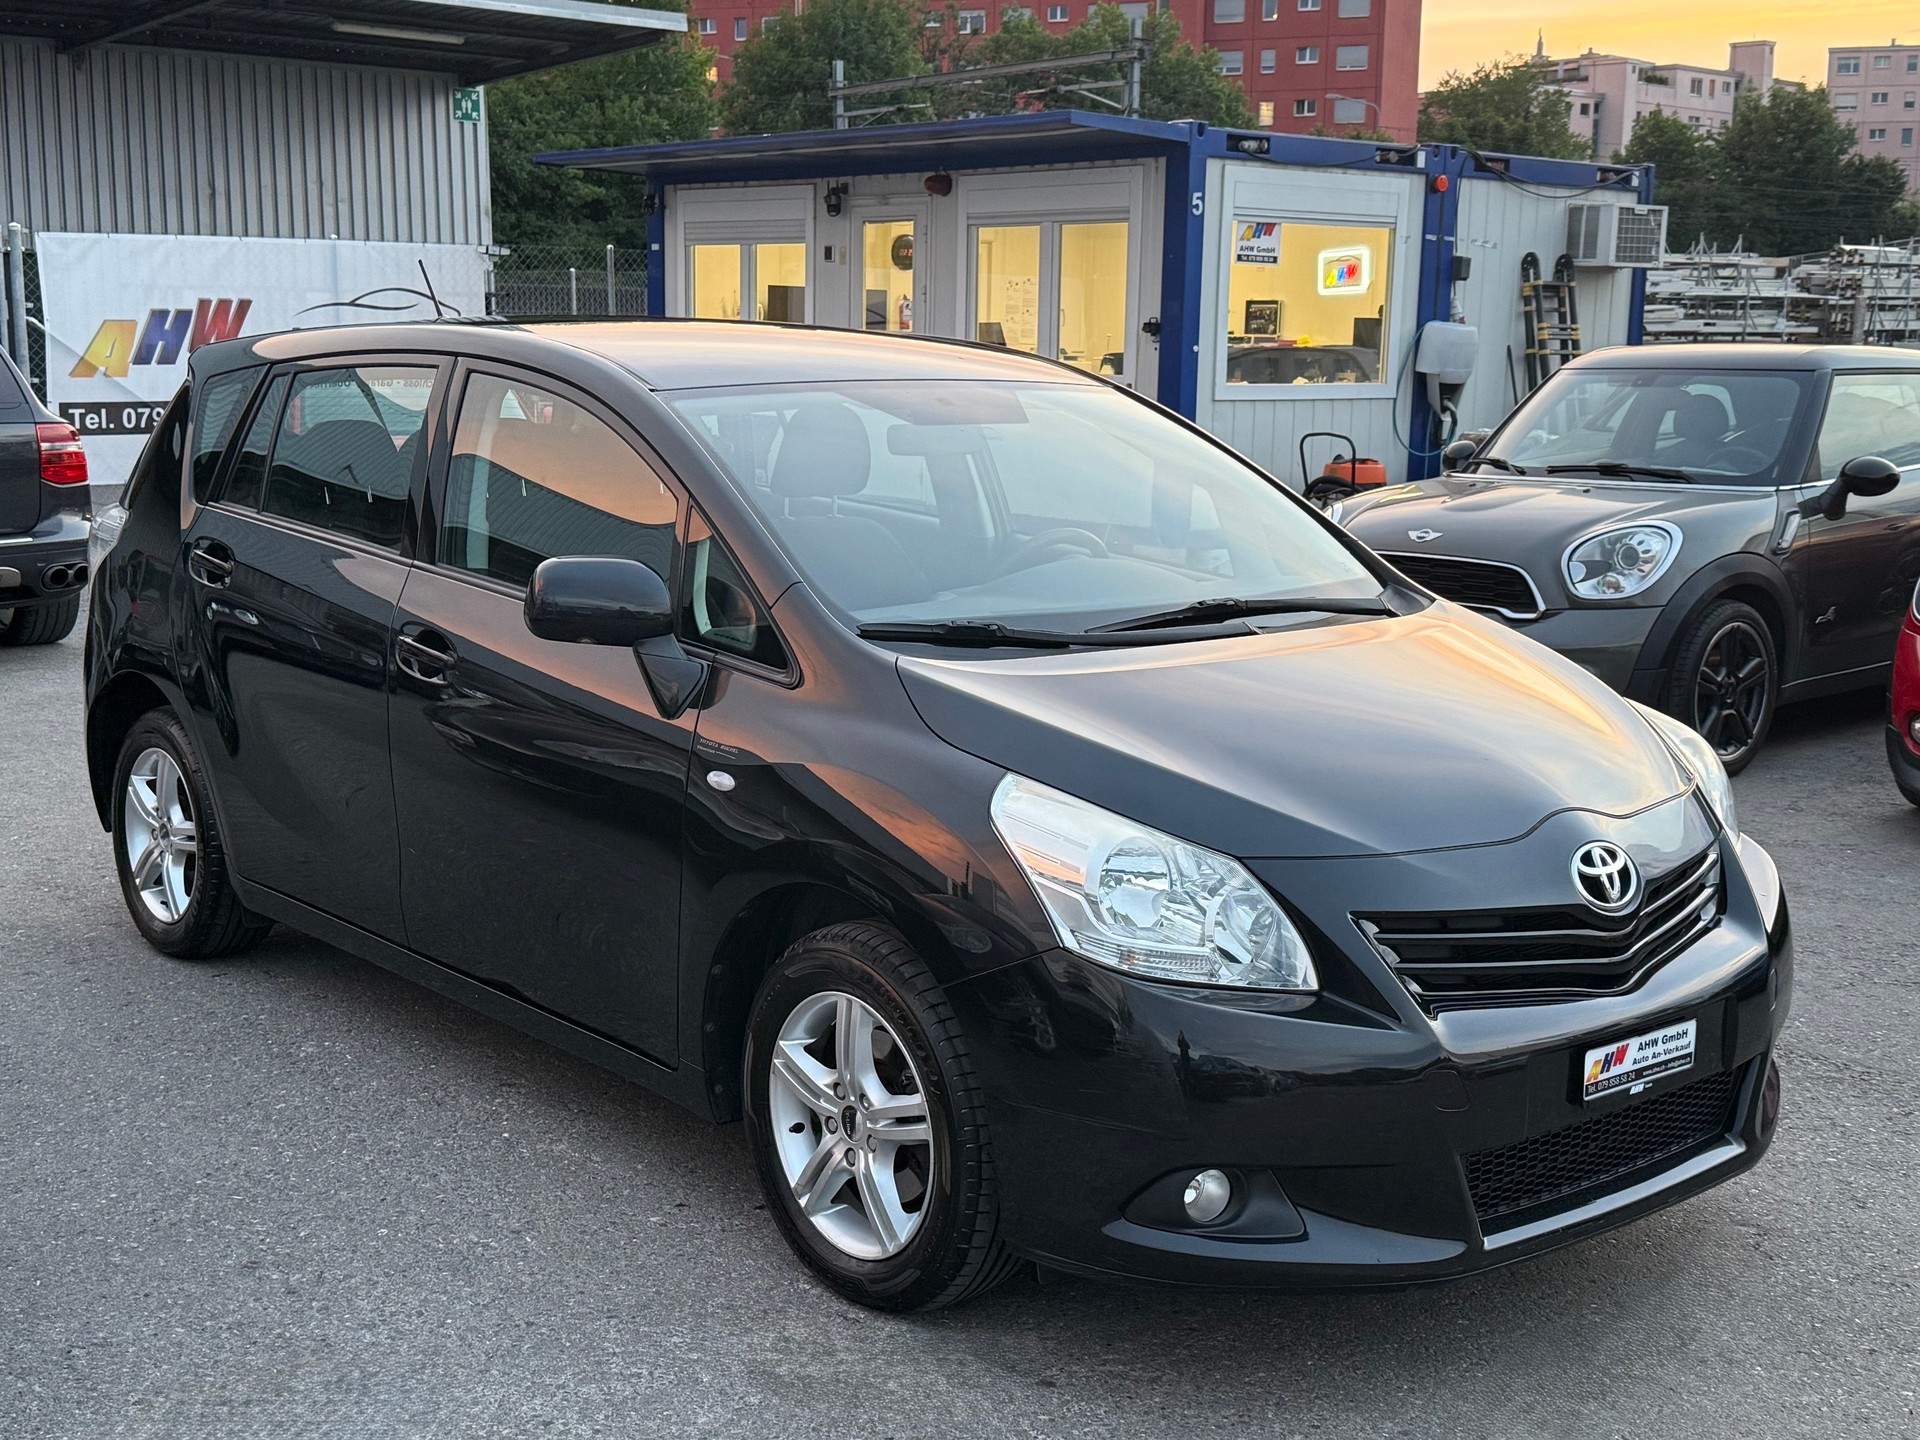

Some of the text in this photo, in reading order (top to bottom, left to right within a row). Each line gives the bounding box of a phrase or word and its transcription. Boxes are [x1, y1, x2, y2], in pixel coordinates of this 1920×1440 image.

[1192, 191, 1203, 216] 5
[1240, 222, 1277, 241] AHW
[1256, 246, 1276, 254] GmbH
[68, 297, 253, 379] AHW
[68, 408, 114, 430] Tel.
[1637, 1028, 1689, 1053] AHW GmbH
[1586, 1043, 1630, 1083] AHW
[1632, 1041, 1692, 1066] Auto An-Verkauf
[1587, 1071, 1636, 1094] Tel. 079 858 58 24
